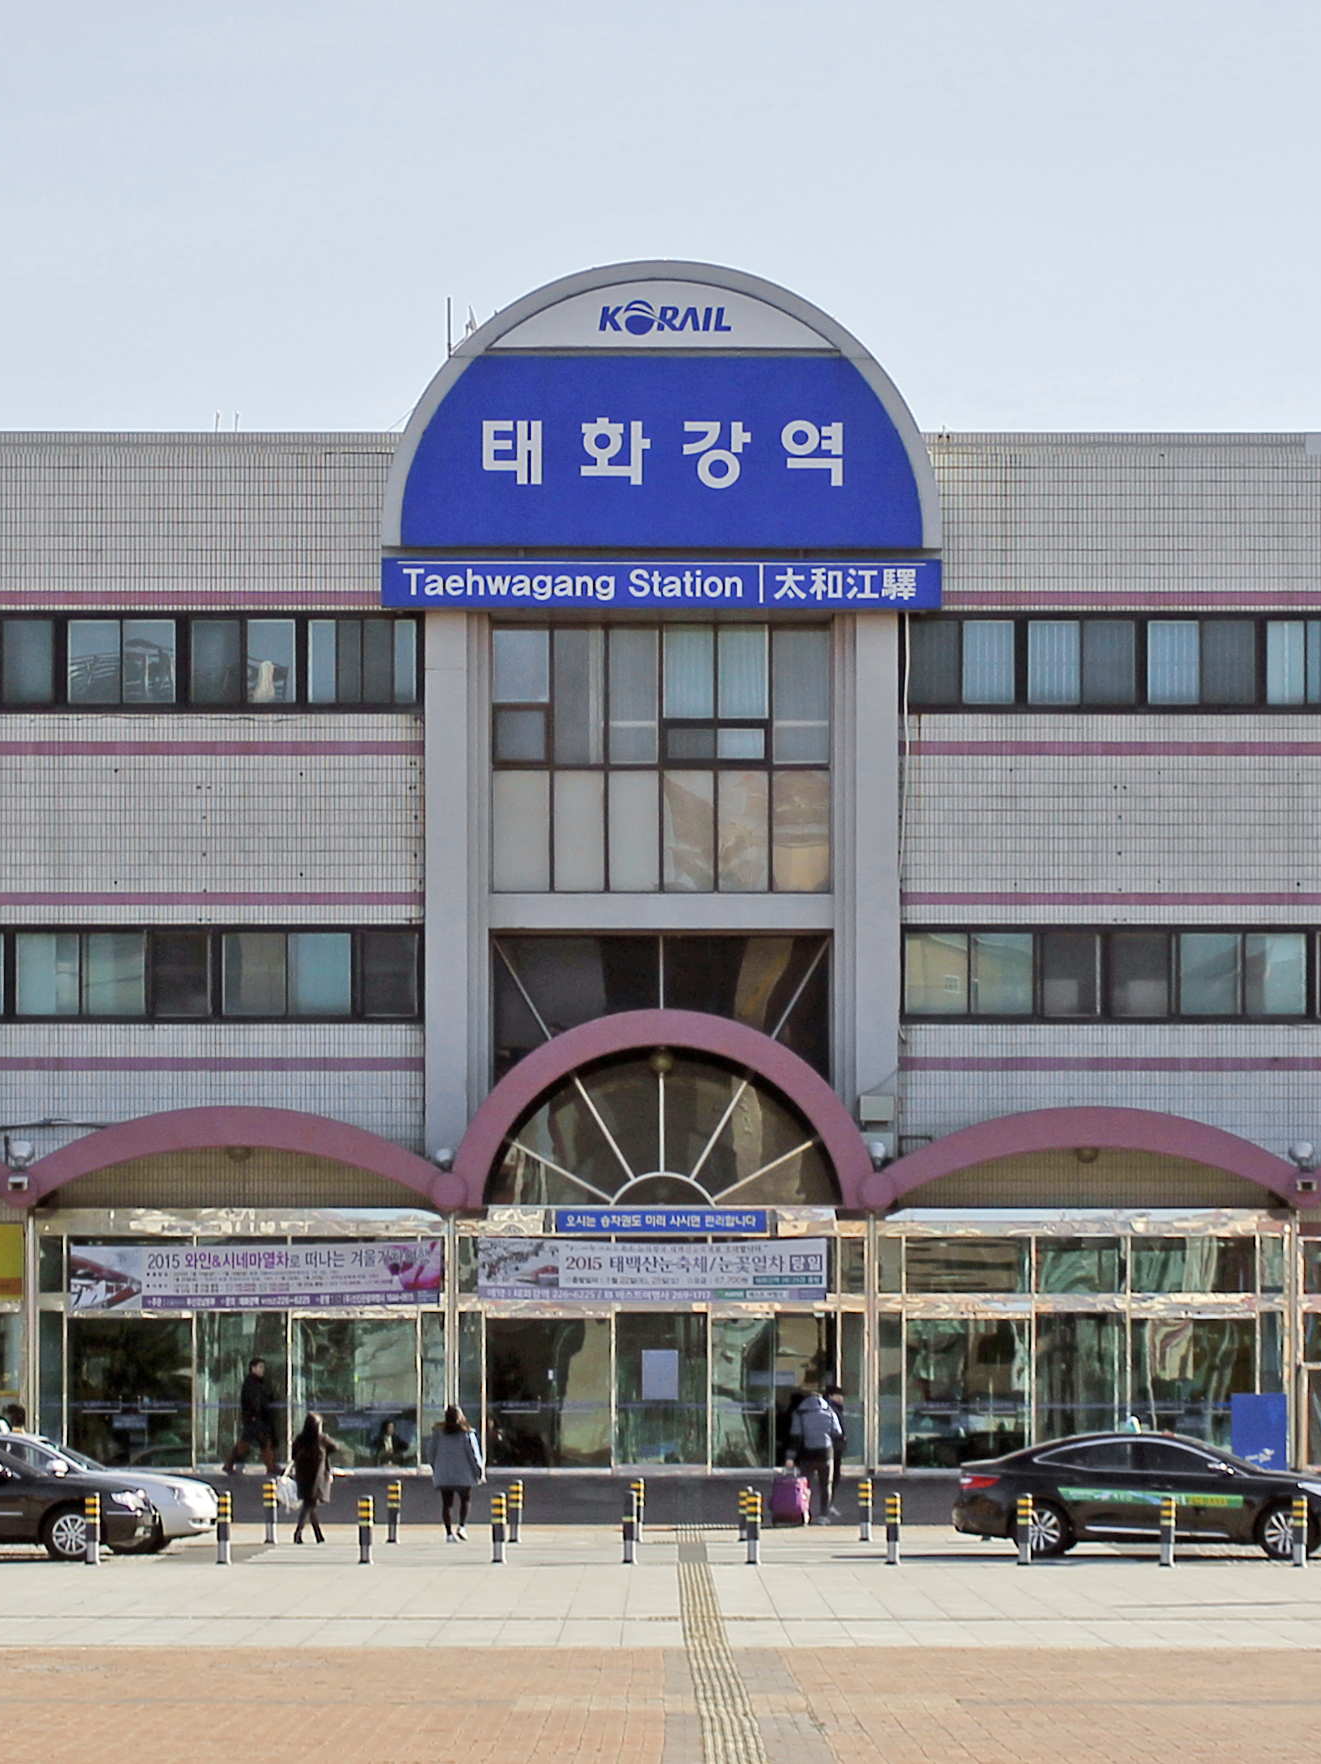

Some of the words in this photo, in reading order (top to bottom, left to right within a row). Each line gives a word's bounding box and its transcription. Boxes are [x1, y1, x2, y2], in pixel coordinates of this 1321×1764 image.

[598, 299, 732, 336] KORAIL
[482, 417, 845, 490] 태화강역
[403, 568, 616, 602] Taehwagang
[629, 568, 744, 598] Station
[773, 566, 918, 601] 太和江驛
[566, 1214, 596, 1228] 오시는
[600, 1214, 642, 1228] 승차권도
[645, 1214, 666, 1228] 미리
[670, 1214, 701, 1228] 사시면
[705, 1214, 757, 1228] 편리합니다
[147, 1254, 180, 1270] 2015
[185, 1251, 301, 1270] 와인&시네마열차로
[305, 1250, 346, 1268] 떠나는
[565, 1256, 603, 1271] 2015
[610, 1254, 785, 1274] 태백산눈축제/눈꽃열차
